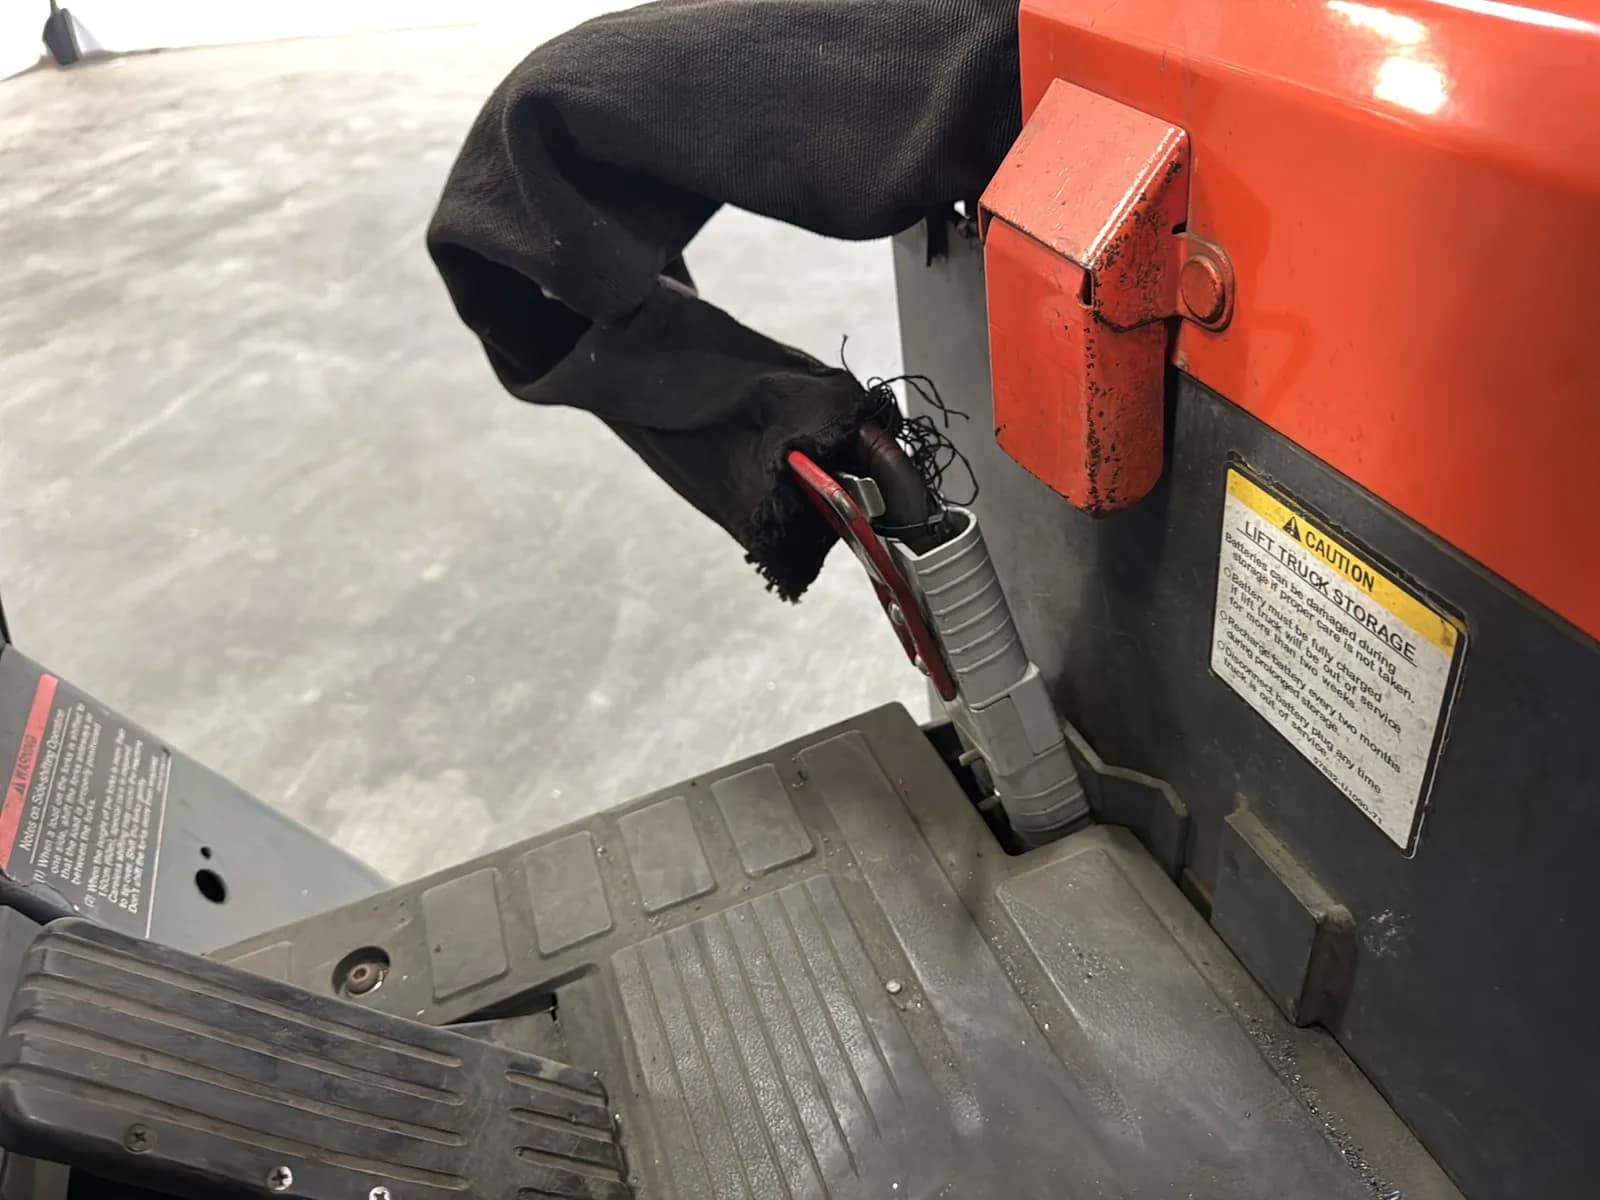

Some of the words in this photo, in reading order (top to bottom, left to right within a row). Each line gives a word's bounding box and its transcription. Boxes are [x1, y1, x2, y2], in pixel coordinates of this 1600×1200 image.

[1305, 528, 1374, 593] CAUTION
[1225, 530, 1267, 572] Batteries
[1270, 567, 1287, 588] can
[1290, 582, 1303, 600] be
[1306, 594, 1357, 644] damaged
[1358, 636, 1397, 676] during
[1244, 520, 1273, 553] LIFT
[1277, 545, 1329, 596] TRUCK
[1332, 586, 1416, 662] STORAGE
[1231, 571, 1266, 609] Battery
[1267, 601, 1292, 629] must
[1295, 623, 1308, 642] be
[1311, 636, 1333, 665] fully
[1336, 658, 1382, 704] charged
[1232, 550, 1268, 588] storage
[1270, 579, 1277, 592] if
[1279, 588, 1314, 624] proper
[1316, 619, 1340, 644] care
[1343, 639, 1353, 654] is
[1356, 649, 1375, 671] not
[1377, 666, 1415, 705] taken.
[1228, 594, 1242, 613] for
[1246, 610, 1269, 636] more
[1273, 632, 1296, 659] than
[1299, 654, 1318, 677] two
[1321, 673, 1359, 713] weeks.
[1230, 582, 1237, 596] if
[1241, 591, 1254, 611] lift
[1257, 605, 1281, 633] truck
[1285, 628, 1302, 650] will
[1305, 645, 1319, 665] be
[1323, 661, 1340, 683] out
[1344, 678, 1356, 696] of
[1360, 692, 1401, 734] service
[1226, 627, 1253, 660] during
[1254, 652, 1300, 701] prolonged
[1300, 693, 1340, 737] storage.
[1227, 614, 1270, 661] Recharge
[1271, 652, 1305, 691] battery
[1307, 686, 1335, 719] every
[1337, 711, 1357, 736] two
[1359, 730, 1401, 774] months
[1223, 655, 1246, 684] truck
[1249, 679, 1257, 693] is
[1259, 688, 1275, 710] out
[1278, 705, 1288, 722] of
[1291, 718, 1330, 761] service.
[1224, 644, 1272, 695] Disconnect
[1275, 690, 1309, 731] battery
[1310, 722, 1334, 753] plug
[1335, 747, 1354, 771] any
[1356, 765, 1381, 795] time
[45, 708, 68, 749] Operation
[30, 749, 57, 804] Side-shifting
[60, 751, 73, 774] forks
[68, 762, 82, 785] forks
[56, 774, 68, 790] the
[64, 786, 76, 803] the
[29, 806, 41, 819] on
[54, 792, 64, 805] on
[102, 796, 113, 809] the
[47, 806, 61, 828] load
[58, 803, 73, 826] shift
[68, 816, 81, 838] load
[18, 820, 37, 849] Notes
[78, 824, 91, 840] the
[95, 820, 110, 848] height
[36, 838, 53, 868] When
[64, 839, 77, 856] the
[92, 848, 103, 863] the
[32, 870, 48, 882] (1)
[49, 854, 62, 873] one
[59, 858, 73, 879] that
[69, 842, 88, 884] between
[86, 864, 100, 892] When
[106, 861, 123, 902] Careless
[127, 886, 140, 912] Don't
